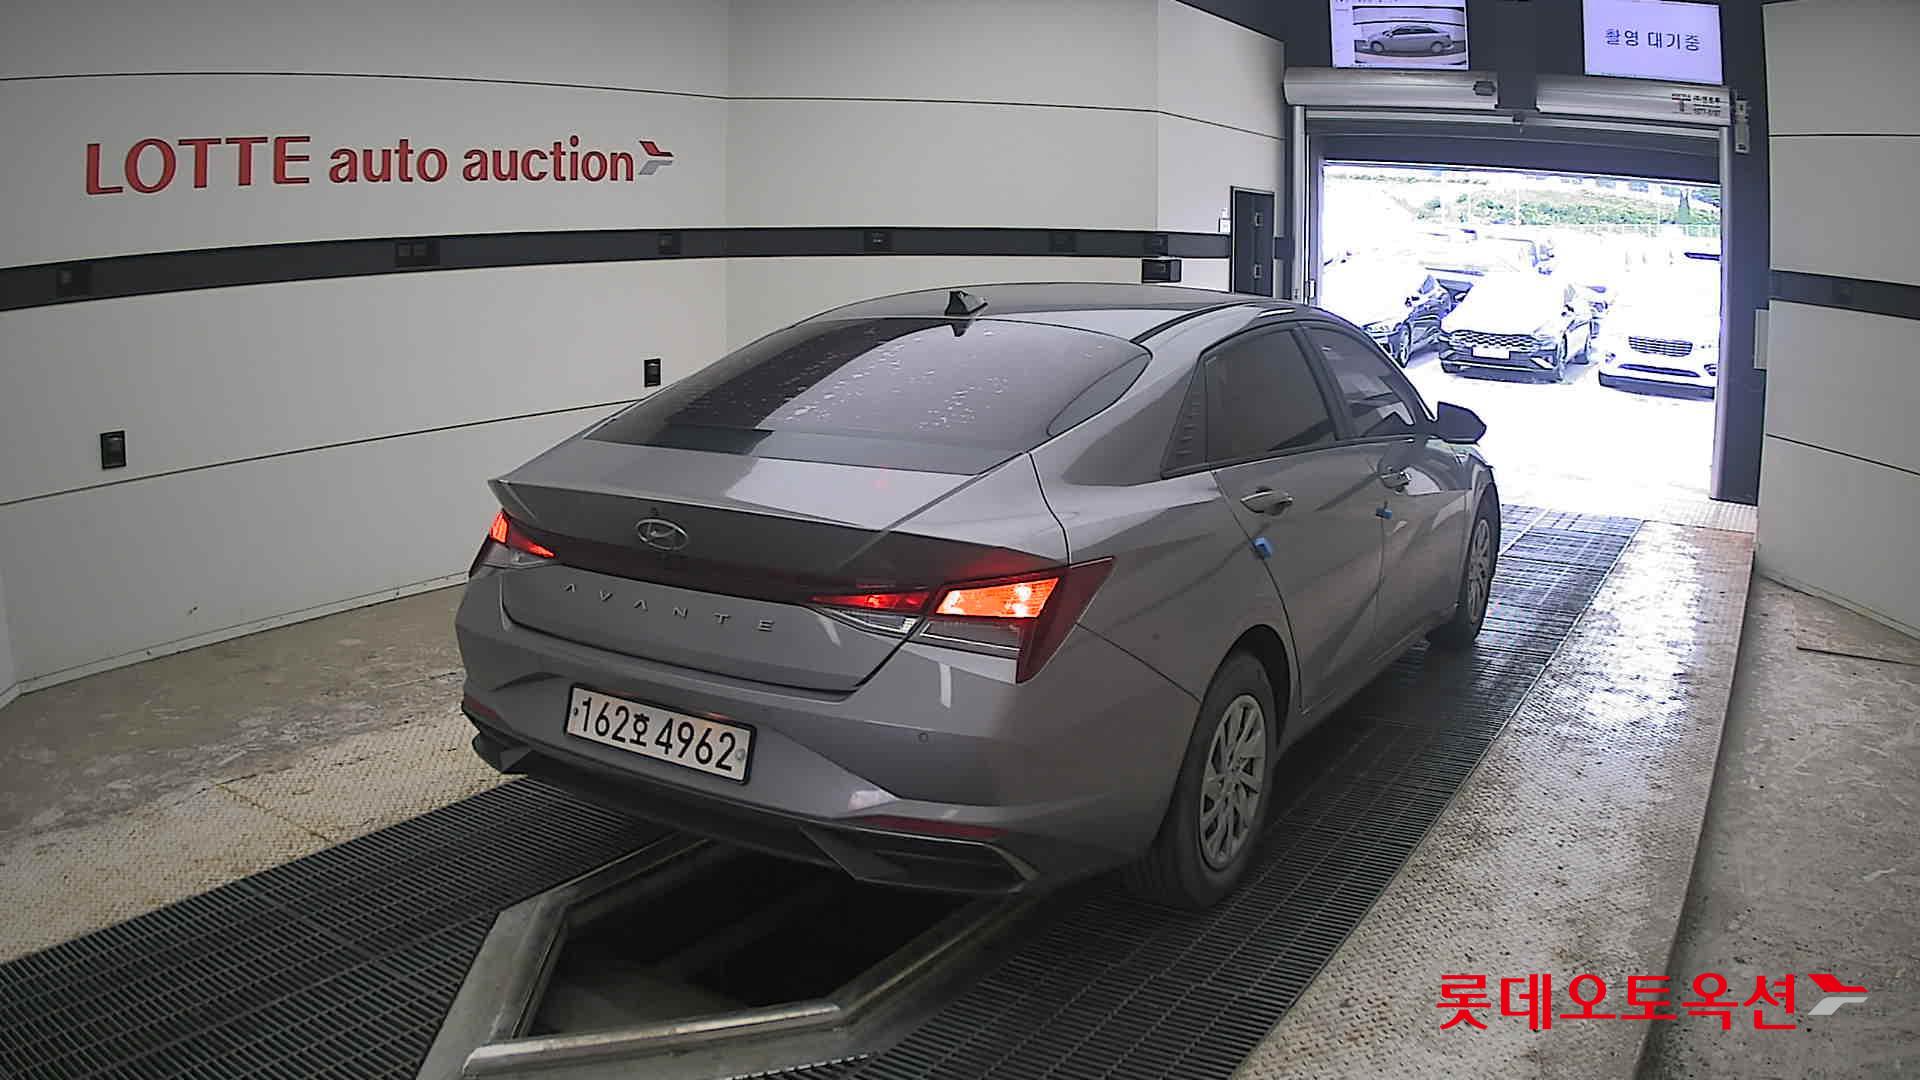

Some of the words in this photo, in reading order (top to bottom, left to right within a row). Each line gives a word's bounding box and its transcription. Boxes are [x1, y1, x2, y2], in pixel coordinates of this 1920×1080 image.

[1647, 31, 1701, 51] 대기중
[86, 136, 309, 195] LOTTE
[329, 140, 449, 183] auto
[463, 136, 635, 182] auction
[563, 583, 775, 632] AVANTE
